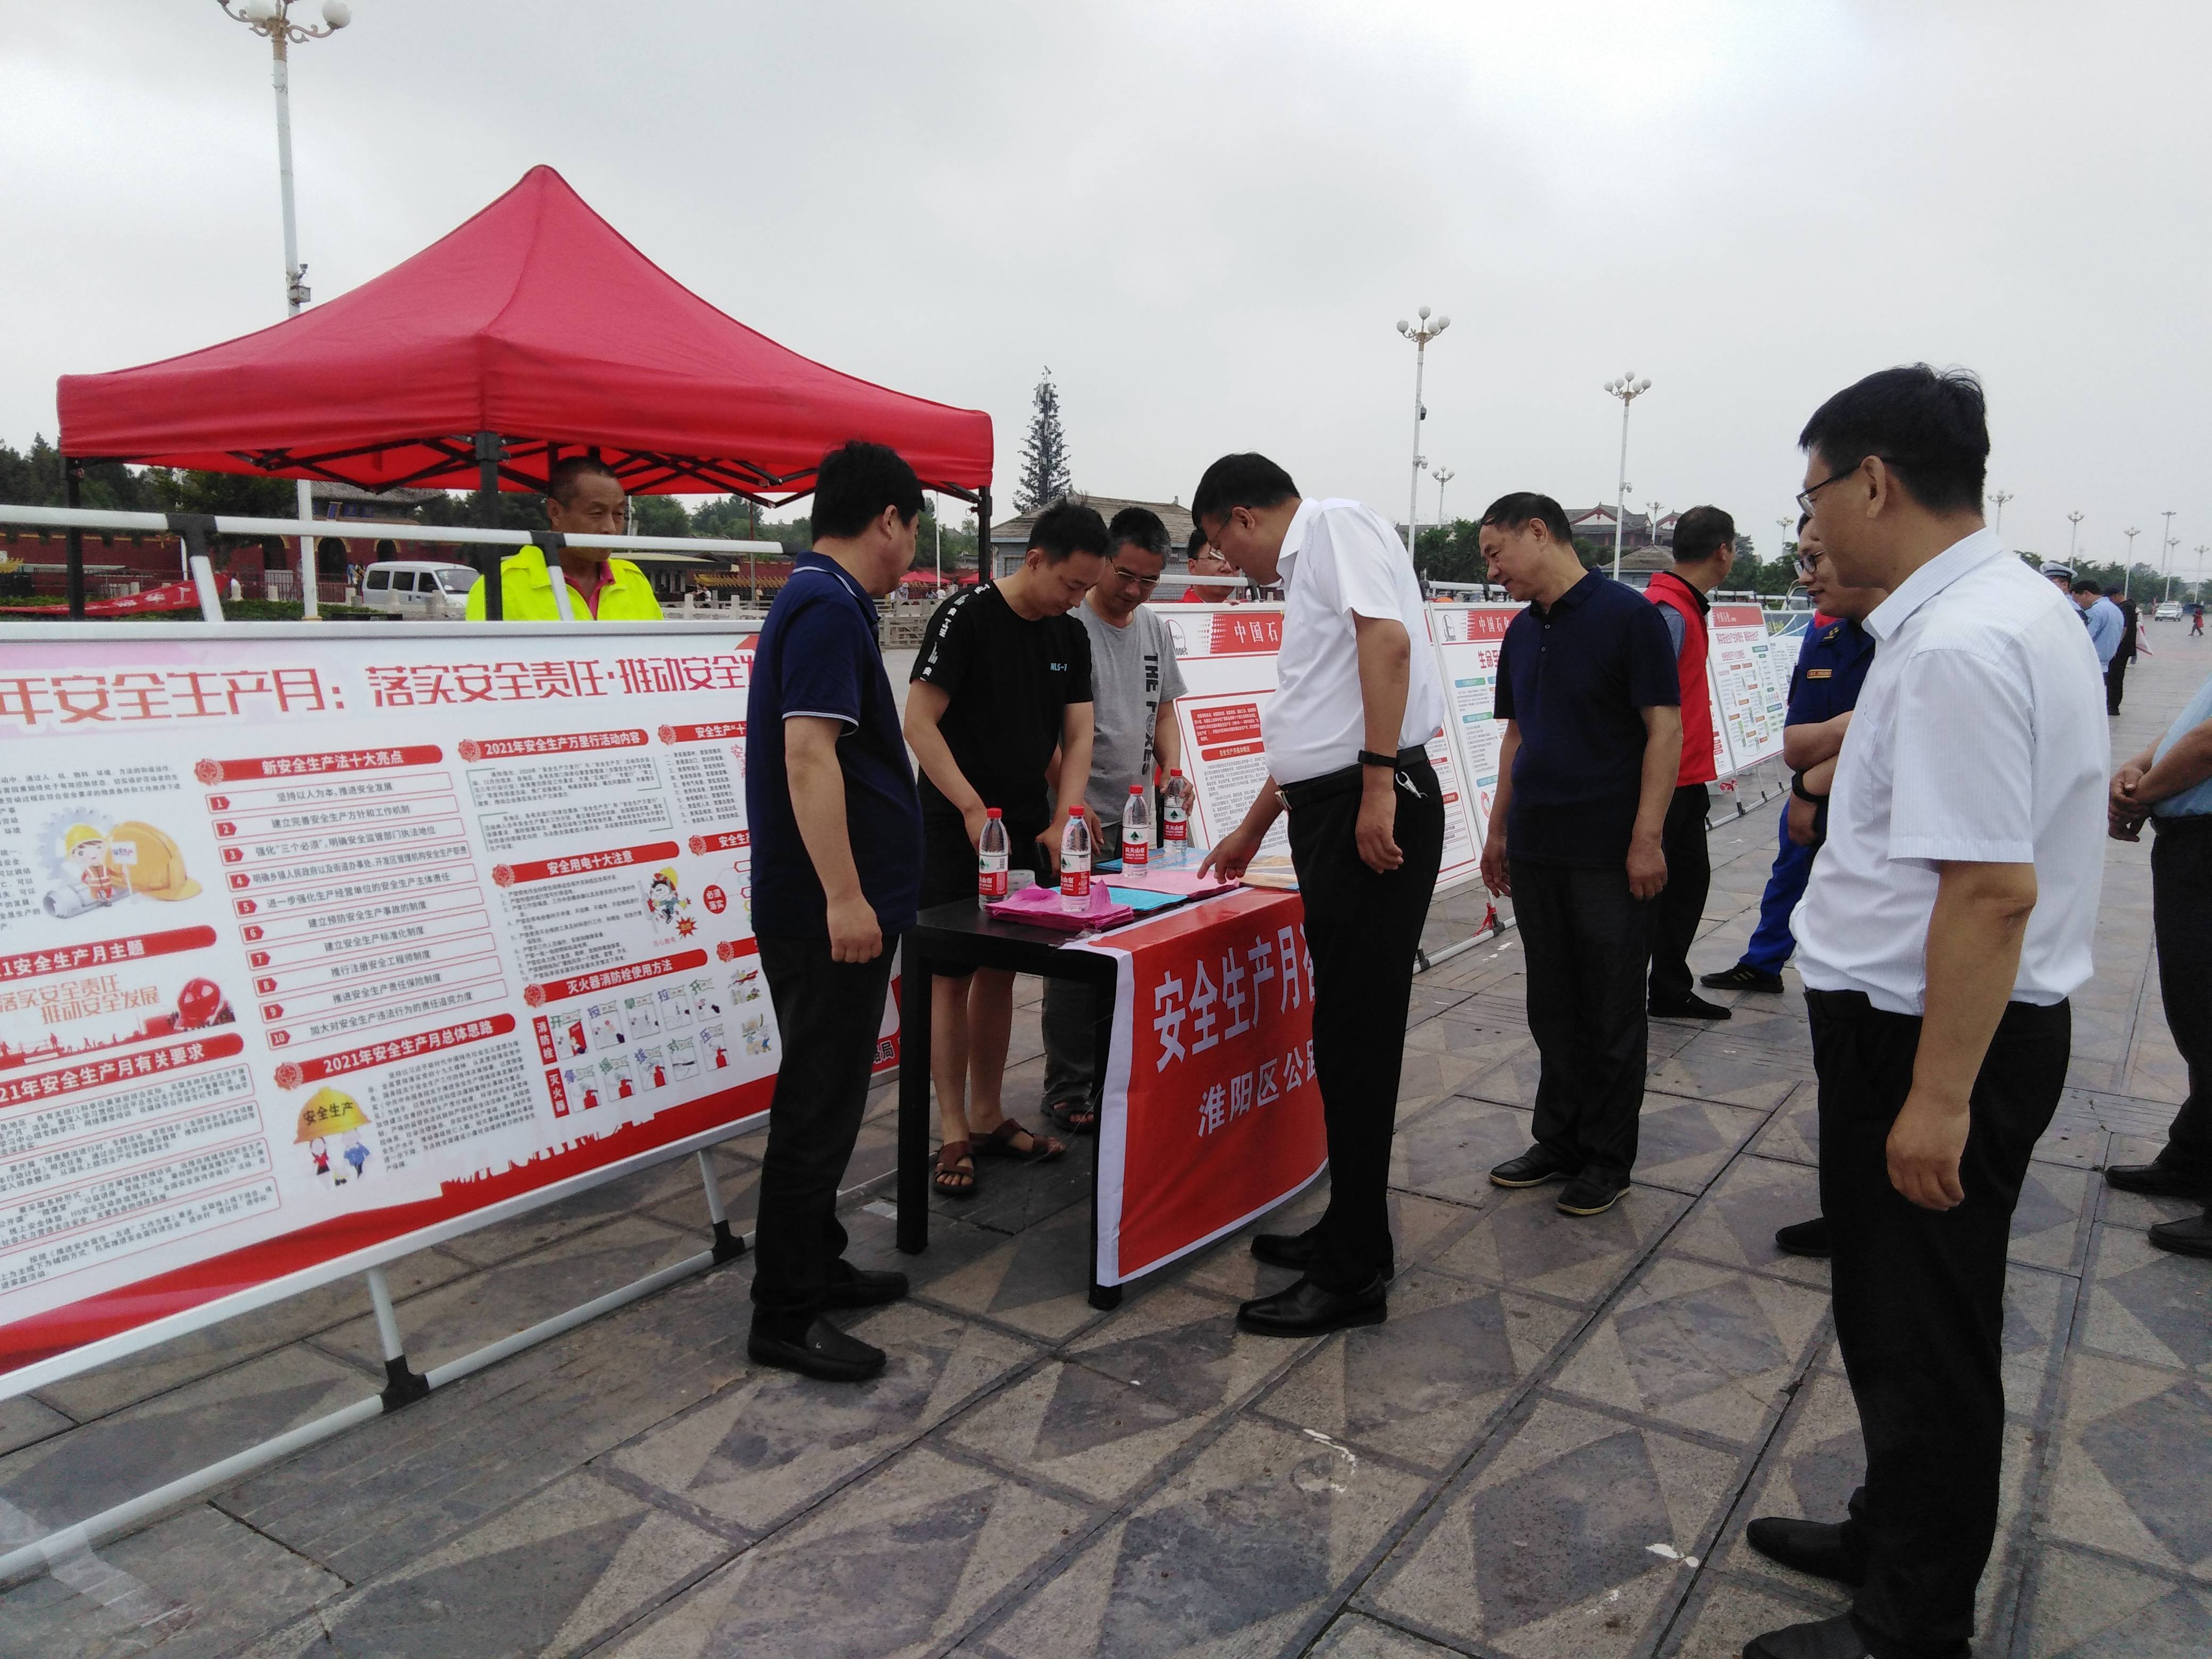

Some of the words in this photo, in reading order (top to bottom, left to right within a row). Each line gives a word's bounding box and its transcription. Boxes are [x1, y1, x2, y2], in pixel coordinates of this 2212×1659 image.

[939, 617, 952, 638] NLS-1
[1050, 663, 1068, 672] NLS-1
[1144, 652, 1159, 692] THE
[485, 731, 641, 756] 2021年安全生产万里行活动内容
[262, 750, 404, 775] 新安全生产法十大亮点
[547, 851, 634, 876] 安全用电十大注意
[308, 901, 427, 928] 建立预防安全生产事故的制度
[324, 925, 425, 952] 建立安全生产标准化制度
[0, 940, 145, 977] 1安全生产月主题
[566, 959, 673, 995] 灭火器消防栓使用方法
[323, 1019, 495, 1074] 2021年安全生产月总体思路
[537, 1020, 555, 1059] 消防栓
[549, 1073, 567, 1113] 灭火器
[303, 1101, 354, 1126] 安全生产
